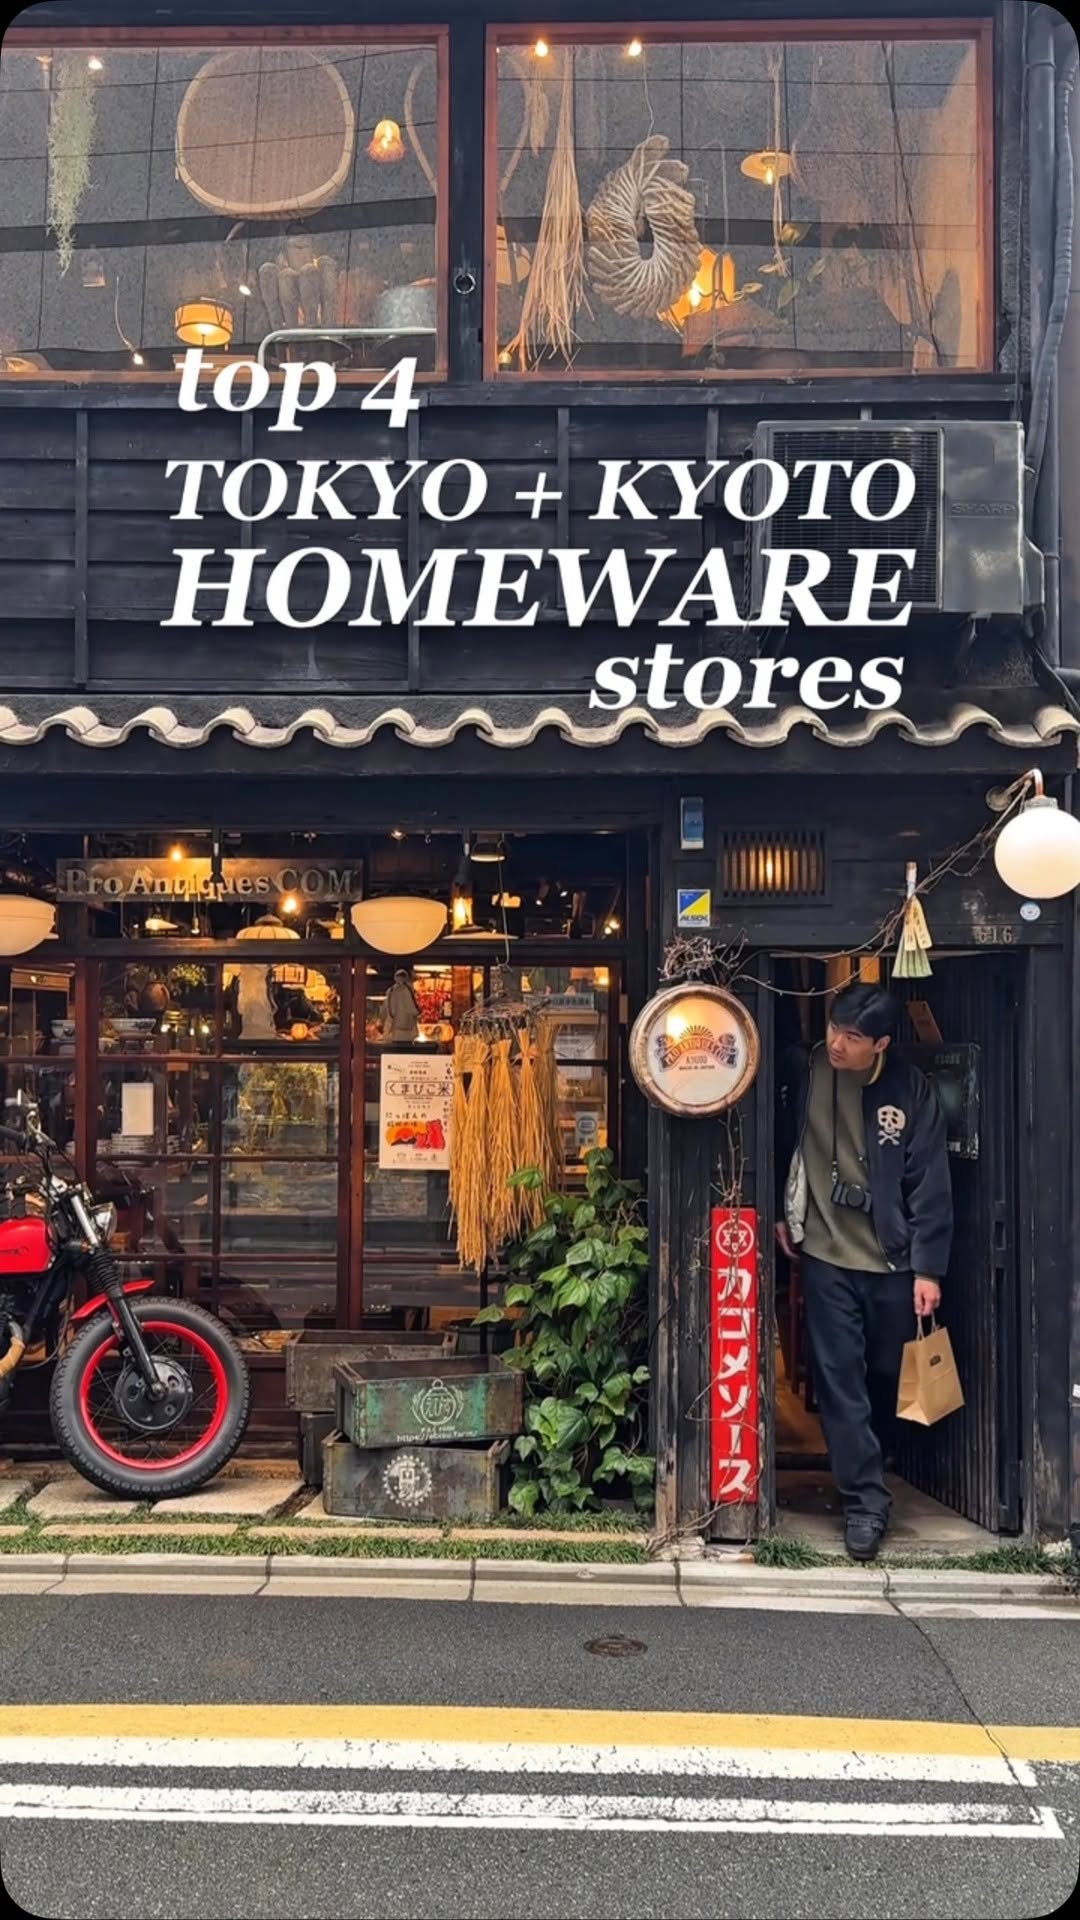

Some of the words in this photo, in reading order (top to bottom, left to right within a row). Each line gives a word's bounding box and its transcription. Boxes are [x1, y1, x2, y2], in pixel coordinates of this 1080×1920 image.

[65, 868, 123, 895] Pro
[717, 1267, 755, 1496] カゴメソース
